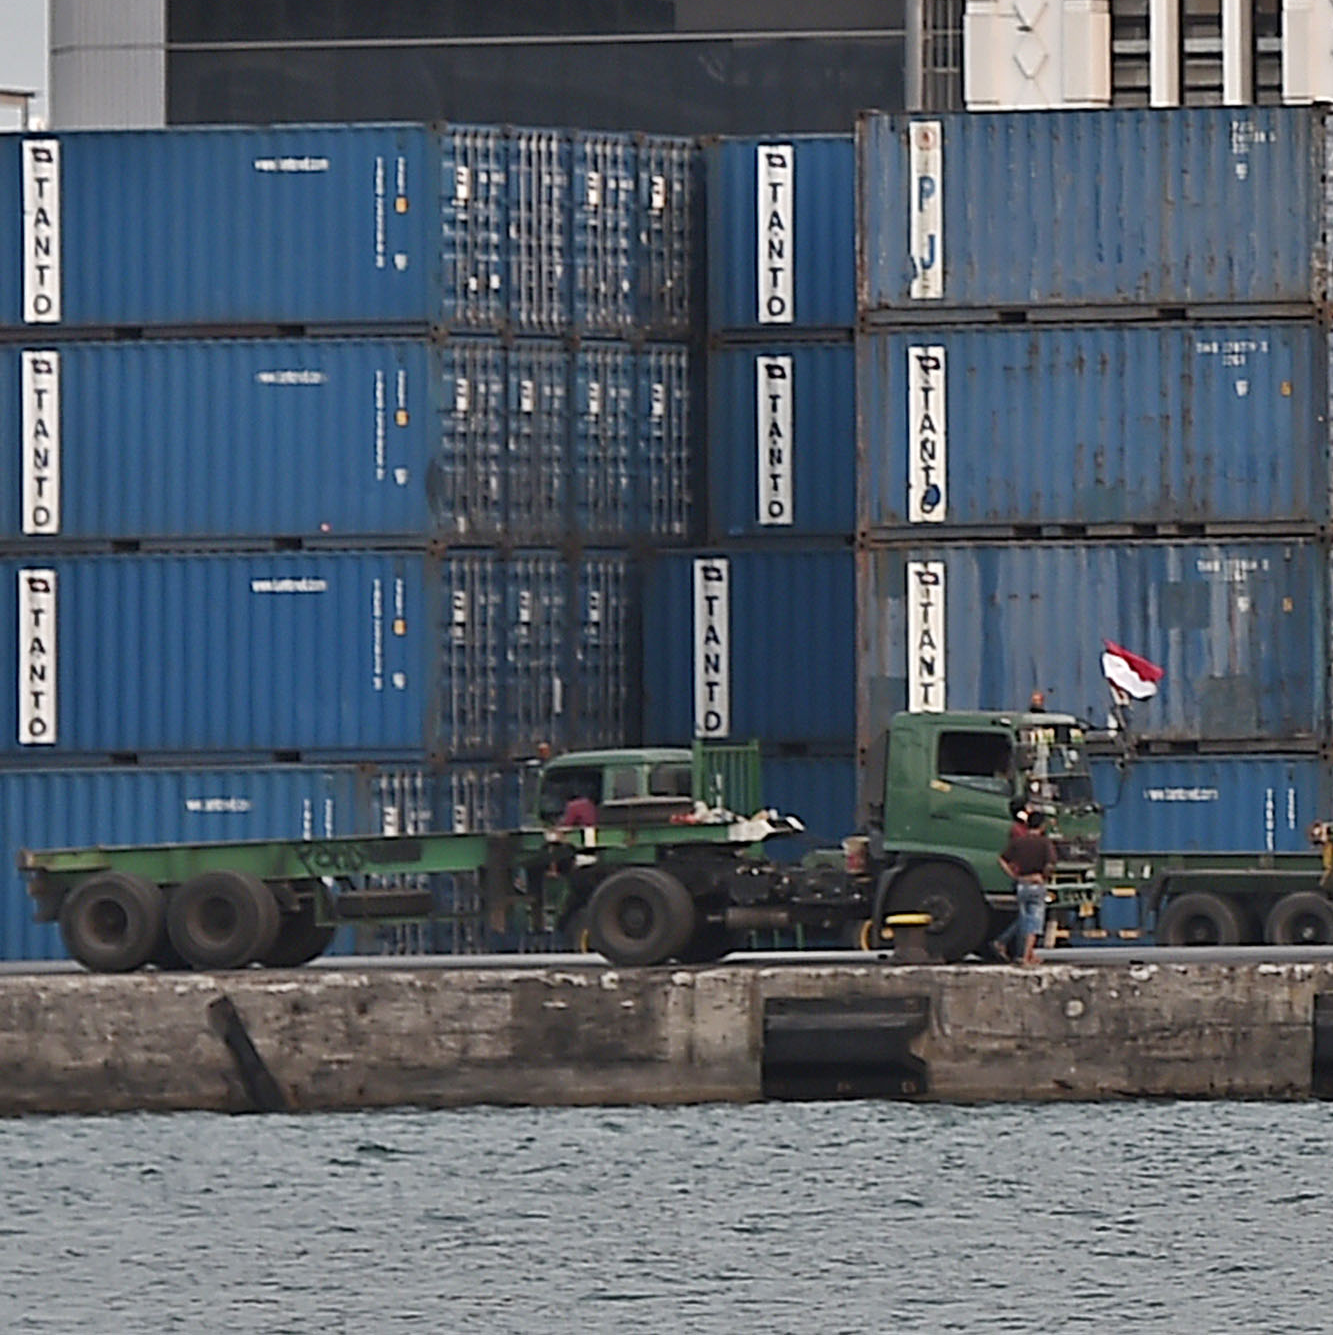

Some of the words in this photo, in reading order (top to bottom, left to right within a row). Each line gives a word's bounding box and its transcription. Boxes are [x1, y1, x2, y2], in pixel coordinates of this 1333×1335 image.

[34, 177, 52, 315] TANTO
[767, 182, 786, 317] TANTO
[33, 388, 50, 528] TANTO
[767, 393, 784, 519] TANTO
[29, 608, 47, 737] TANTO
[703, 594, 723, 733] TANTO
[919, 601, 936, 706] TANT
